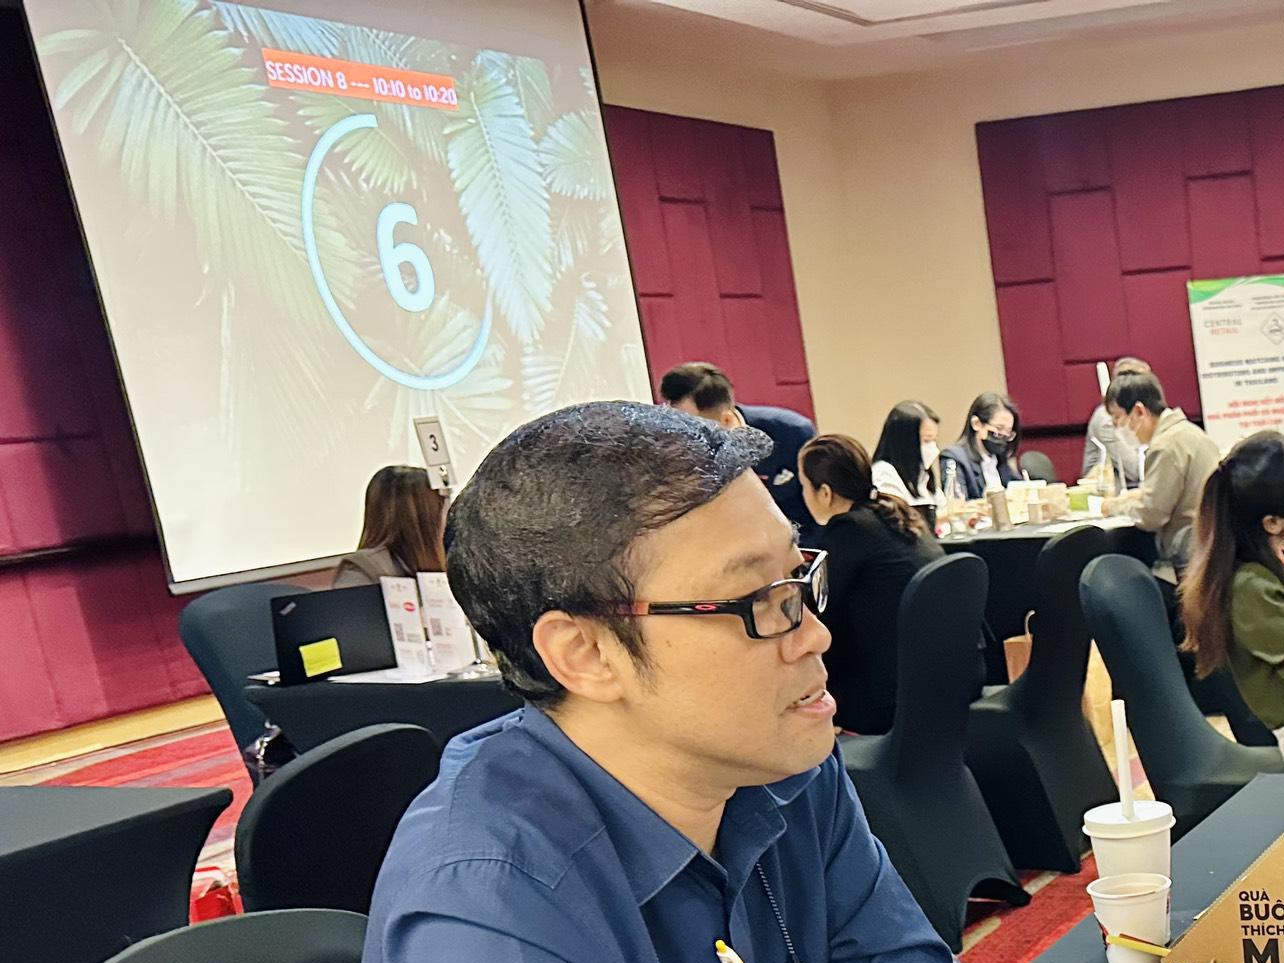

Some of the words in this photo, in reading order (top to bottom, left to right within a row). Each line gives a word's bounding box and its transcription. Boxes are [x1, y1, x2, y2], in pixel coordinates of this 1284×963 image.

[265, 60, 333, 88] SESSION
[336, 72, 347, 90] 8
[373, 77, 404, 98] 10:10
[408, 86, 421, 100] to
[424, 85, 457, 105] 10:20
[377, 201, 435, 313] 6
[429, 434, 439, 451] 3
[1239, 888, 1270, 902] QUÀ
